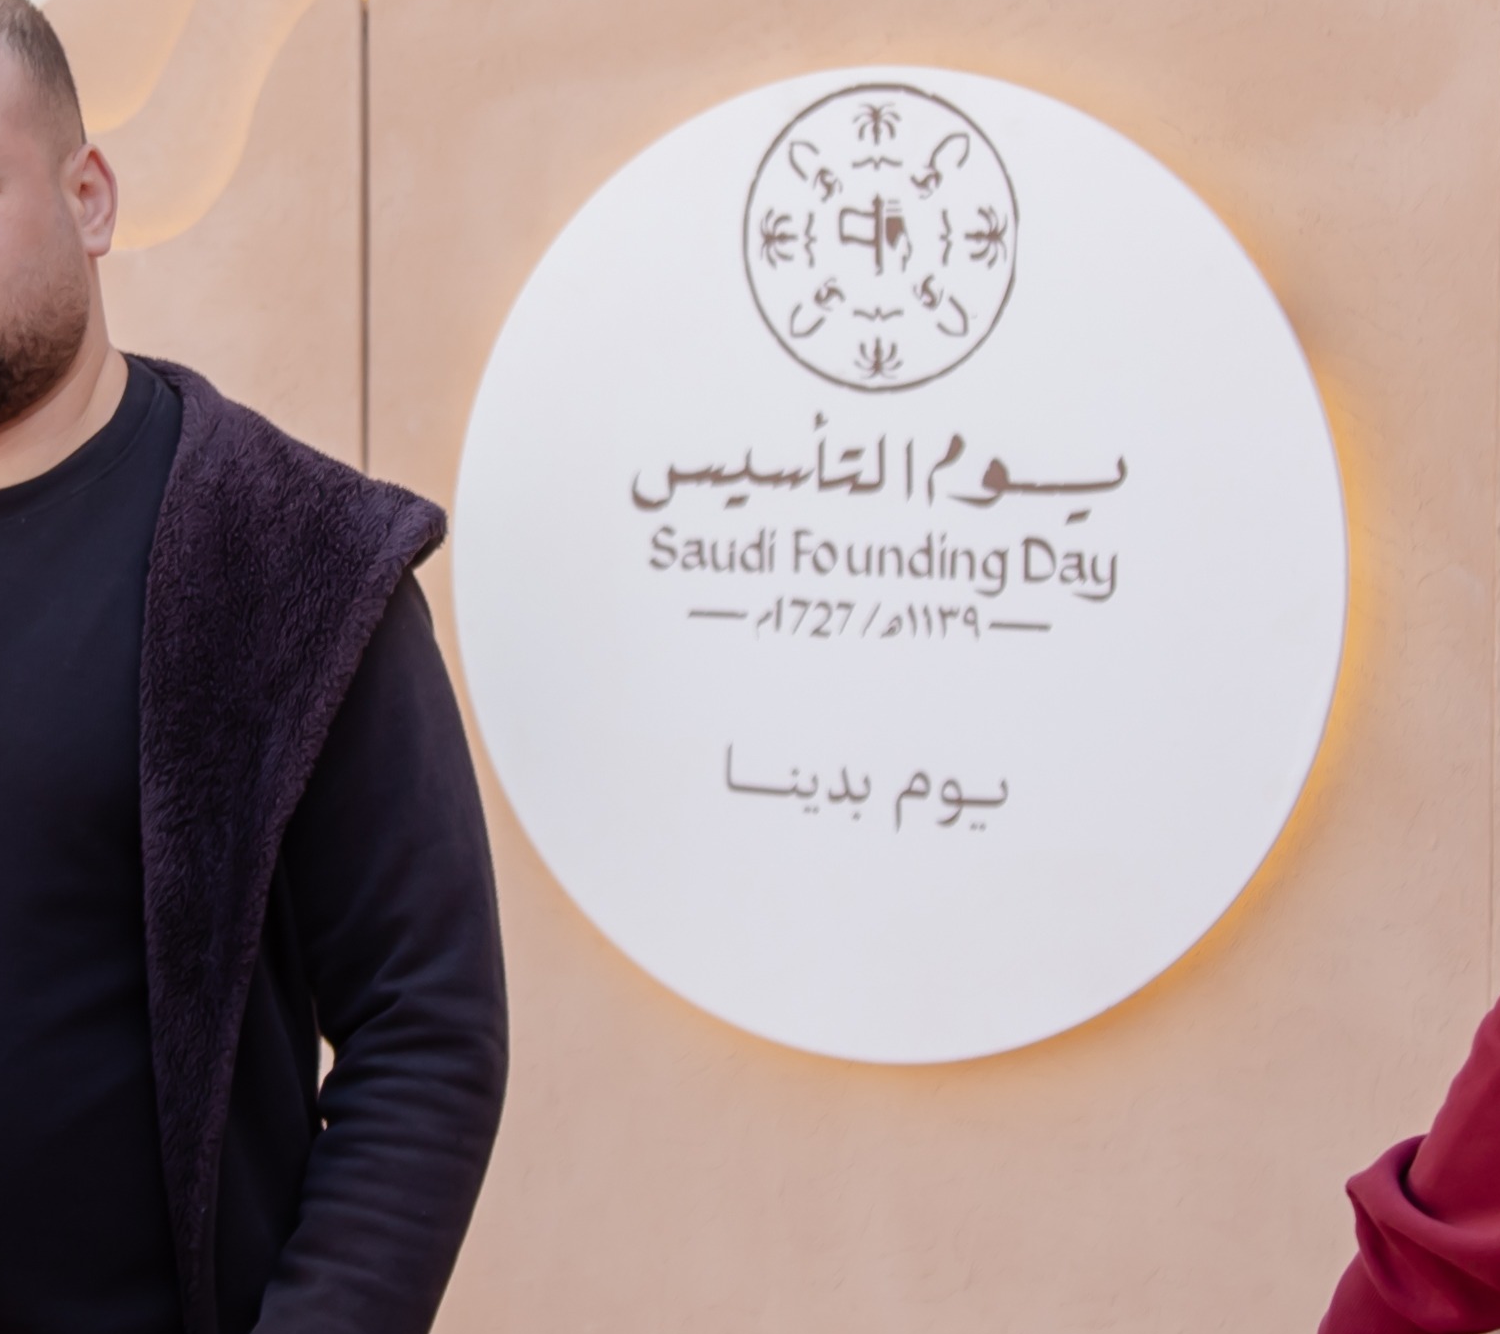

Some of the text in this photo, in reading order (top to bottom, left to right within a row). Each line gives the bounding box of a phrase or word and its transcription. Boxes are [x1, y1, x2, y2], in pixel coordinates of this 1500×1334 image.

[631, 411, 1128, 526] يوم التأسيس
[648, 524, 1120, 602] Saudi Founding Day
[724, 741, 1009, 833] يوم بدينا
